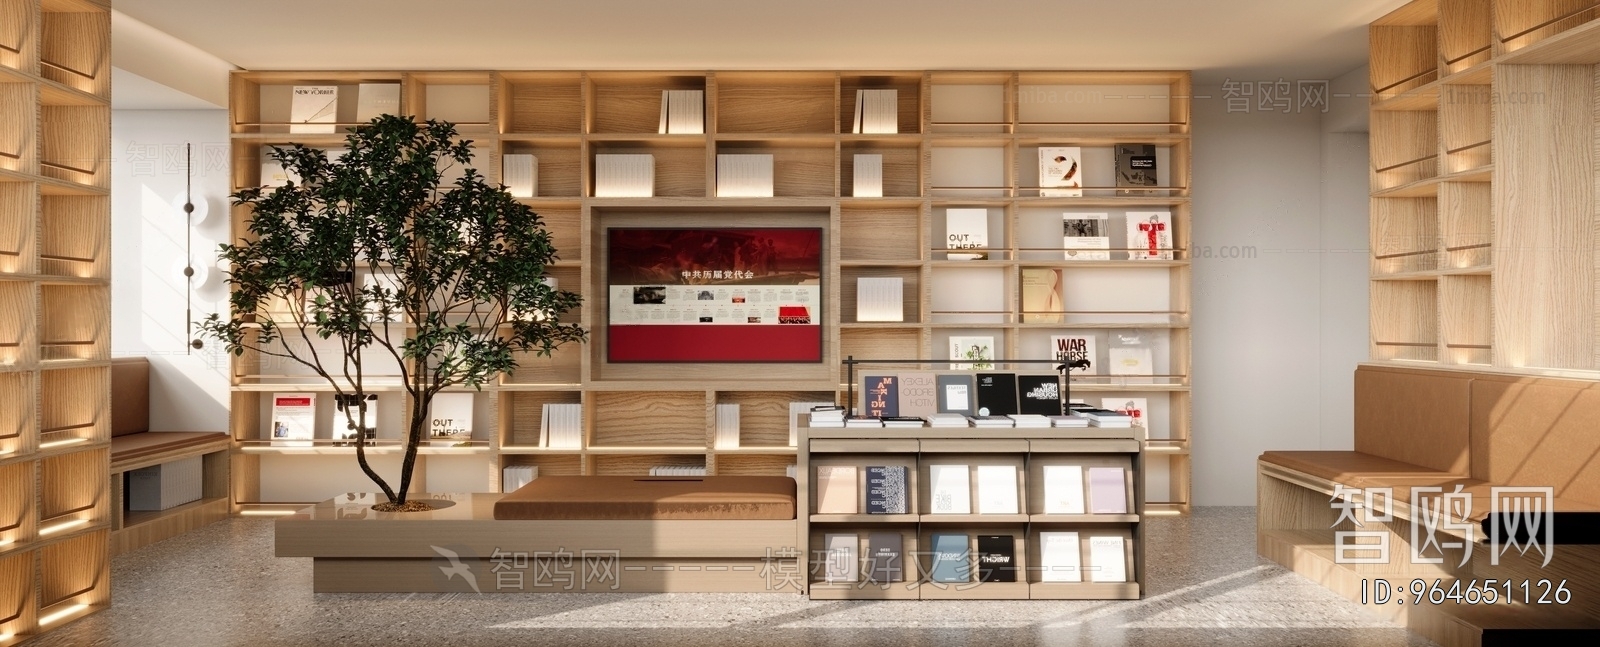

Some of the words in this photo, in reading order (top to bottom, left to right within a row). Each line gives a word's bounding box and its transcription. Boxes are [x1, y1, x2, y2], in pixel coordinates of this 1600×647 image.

[949, 234, 969, 242] OUT
[681, 270, 755, 279] 中共历届党代会
[1057, 339, 1087, 351] WAR
[433, 419, 453, 427] OUT
